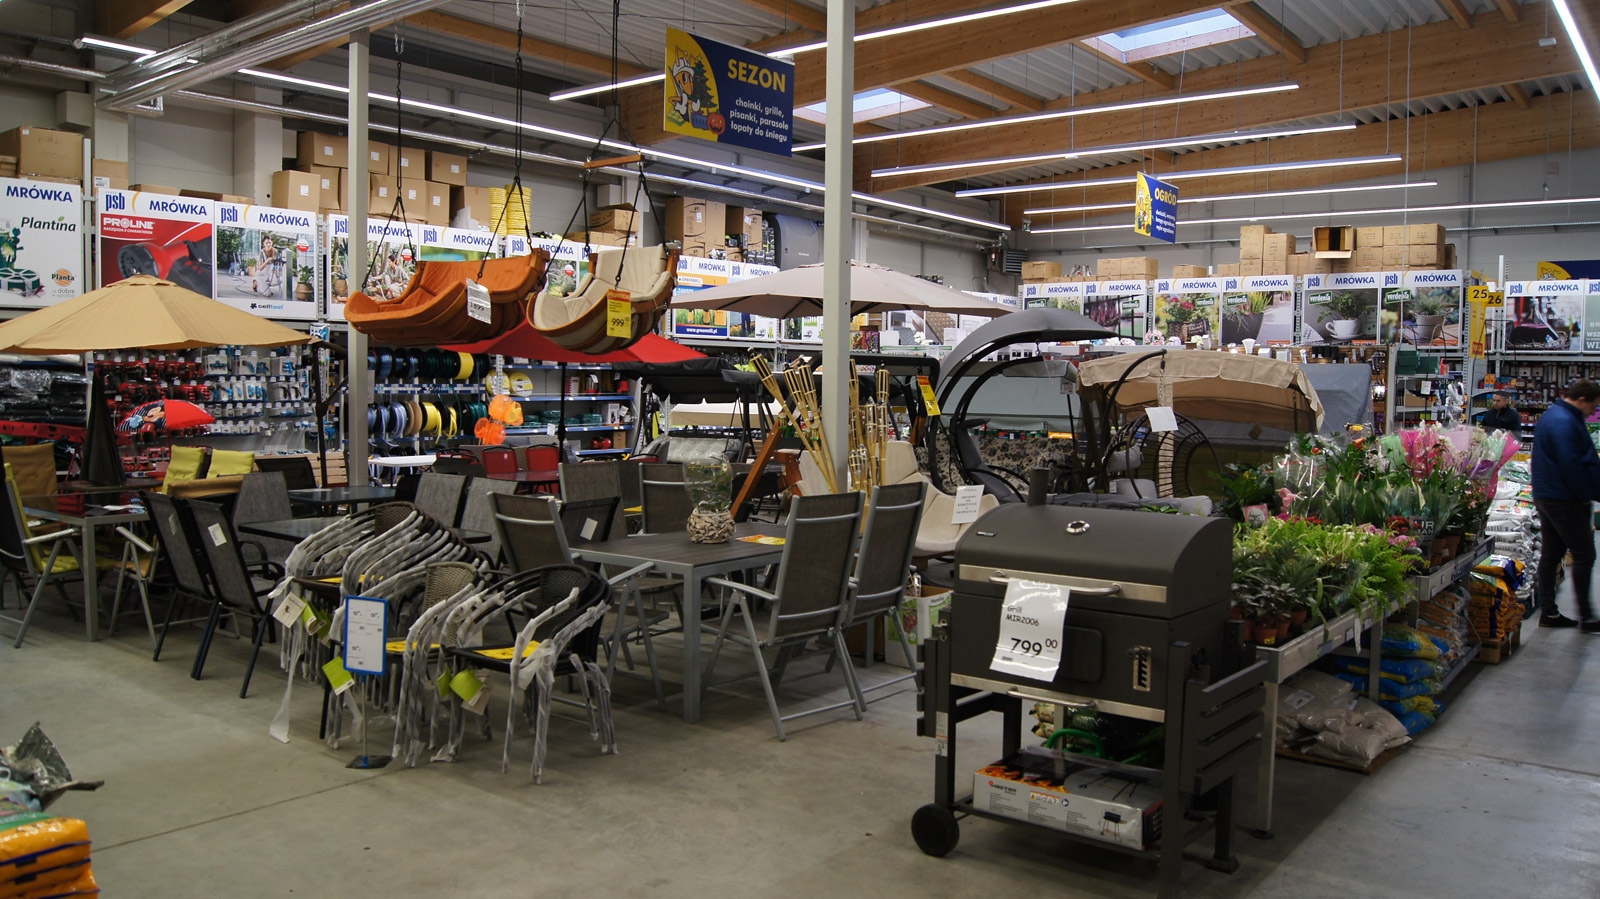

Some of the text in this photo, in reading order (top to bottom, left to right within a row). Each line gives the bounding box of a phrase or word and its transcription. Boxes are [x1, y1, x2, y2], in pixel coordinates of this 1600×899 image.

[728, 58, 786, 93] SEZON
[735, 97, 784, 118] choinki, grille,
[730, 109, 789, 130] pisanki, parasole
[730, 120, 788, 142] łopaty do śniegu
[6, 184, 73, 203] MRÓWKA
[1154, 187, 1177, 206] OGRÓD
[106, 192, 208, 216] psb MRÓWKA
[21, 216, 76, 232] Plantina
[104, 217, 154, 230] PROLINE
[220, 206, 310, 228] psb MRÓWKA
[368, 224, 413, 238] MRÓWKA
[424, 228, 493, 247] psb MRÓWKA
[512, 238, 574, 256] psb MRÓWKA
[698, 261, 726, 272] MRÓWKA
[732, 264, 740, 276] psb
[1158, 280, 1218, 292] psb MRÓWKA
[1225, 278, 1289, 291] psb MRÓWKA
[1307, 275, 1375, 289] psb MRÓWKA
[1385, 272, 1457, 286] psb MRÓWKA
[1026, 286, 1079, 297] psb MRÓWKA
[1086, 282, 1142, 295] psb MRÓWKA
[1472, 290, 1488, 299] 25
[1510, 282, 1579, 295] psb MRÓWKA
[1310, 294, 1331, 302] verdenia
[1488, 295, 1502, 304] 26
[611, 317, 624, 327] 999
[1008, 605, 1022, 614] Grill
[1006, 614, 1040, 627] MIR2006
[1011, 637, 1058, 658] 799 00
